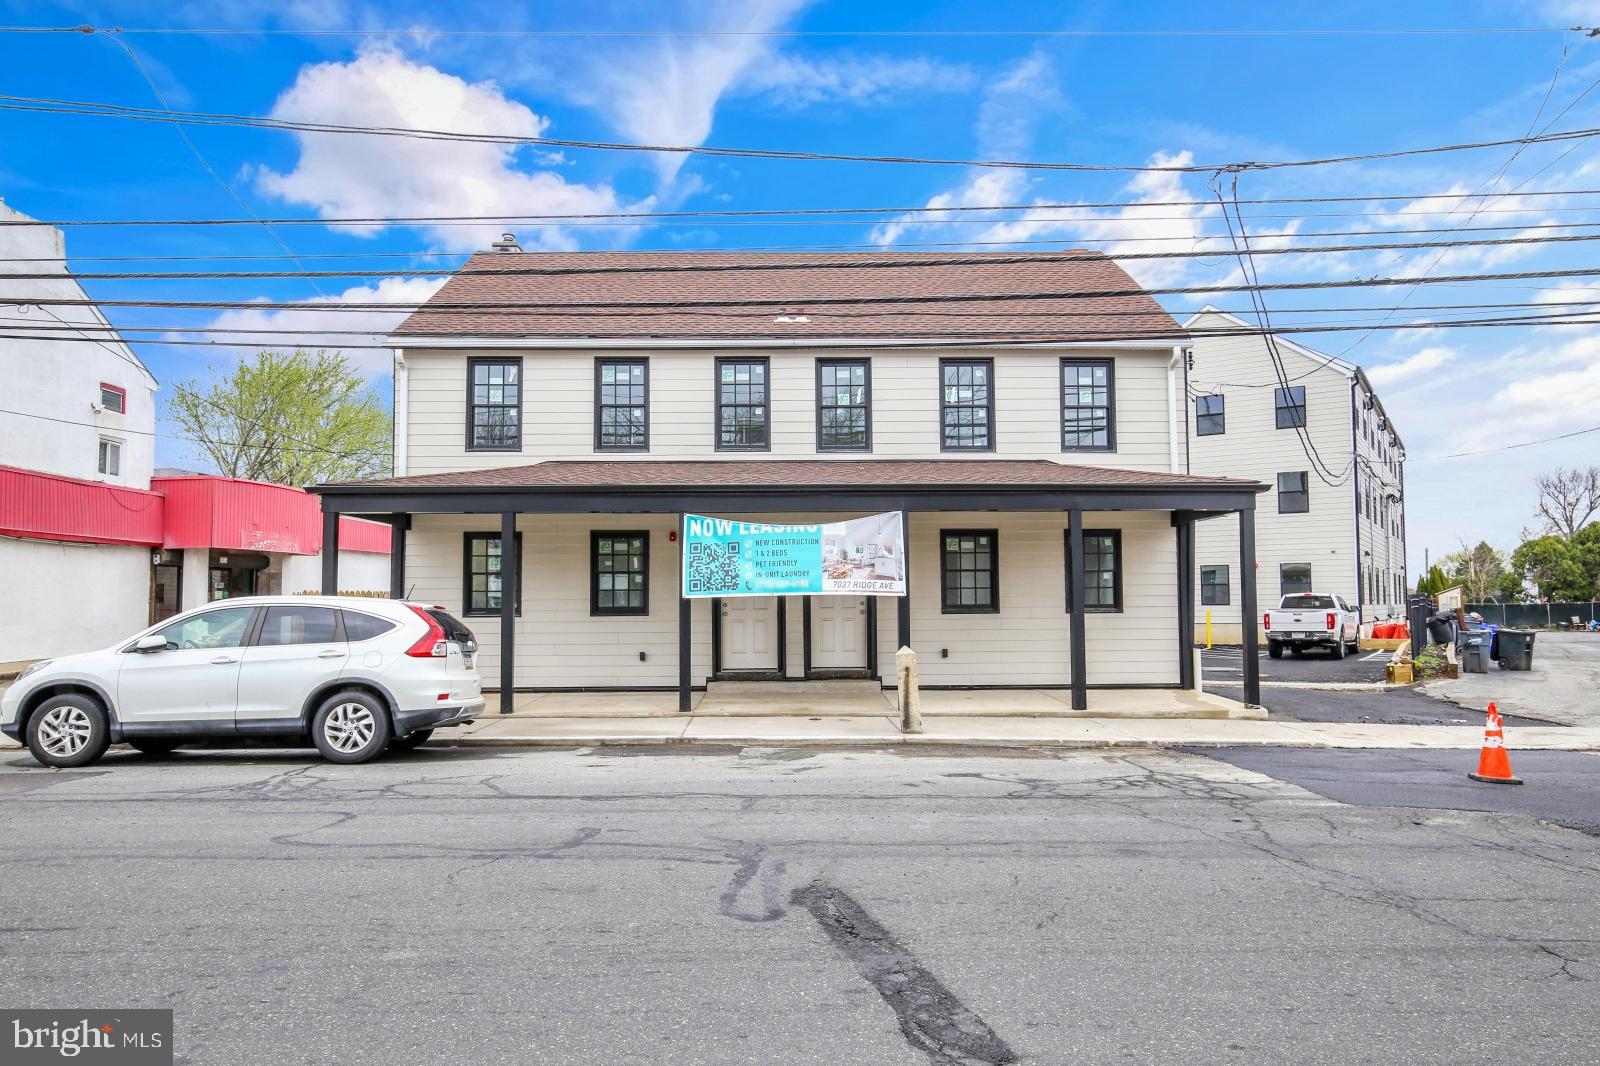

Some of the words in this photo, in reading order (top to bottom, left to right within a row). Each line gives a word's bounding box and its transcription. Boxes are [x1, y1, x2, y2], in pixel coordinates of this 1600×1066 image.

[690, 519, 732, 536] NOW
[771, 538, 819, 546] CONSTRUCTION
[769, 559, 798, 567] FRIENDLY
[755, 570, 779, 578] IN-UNIT
[833, 580, 851, 589] 7037
[853, 581, 877, 589] RIDGE
[878, 582, 894, 590] AVE
